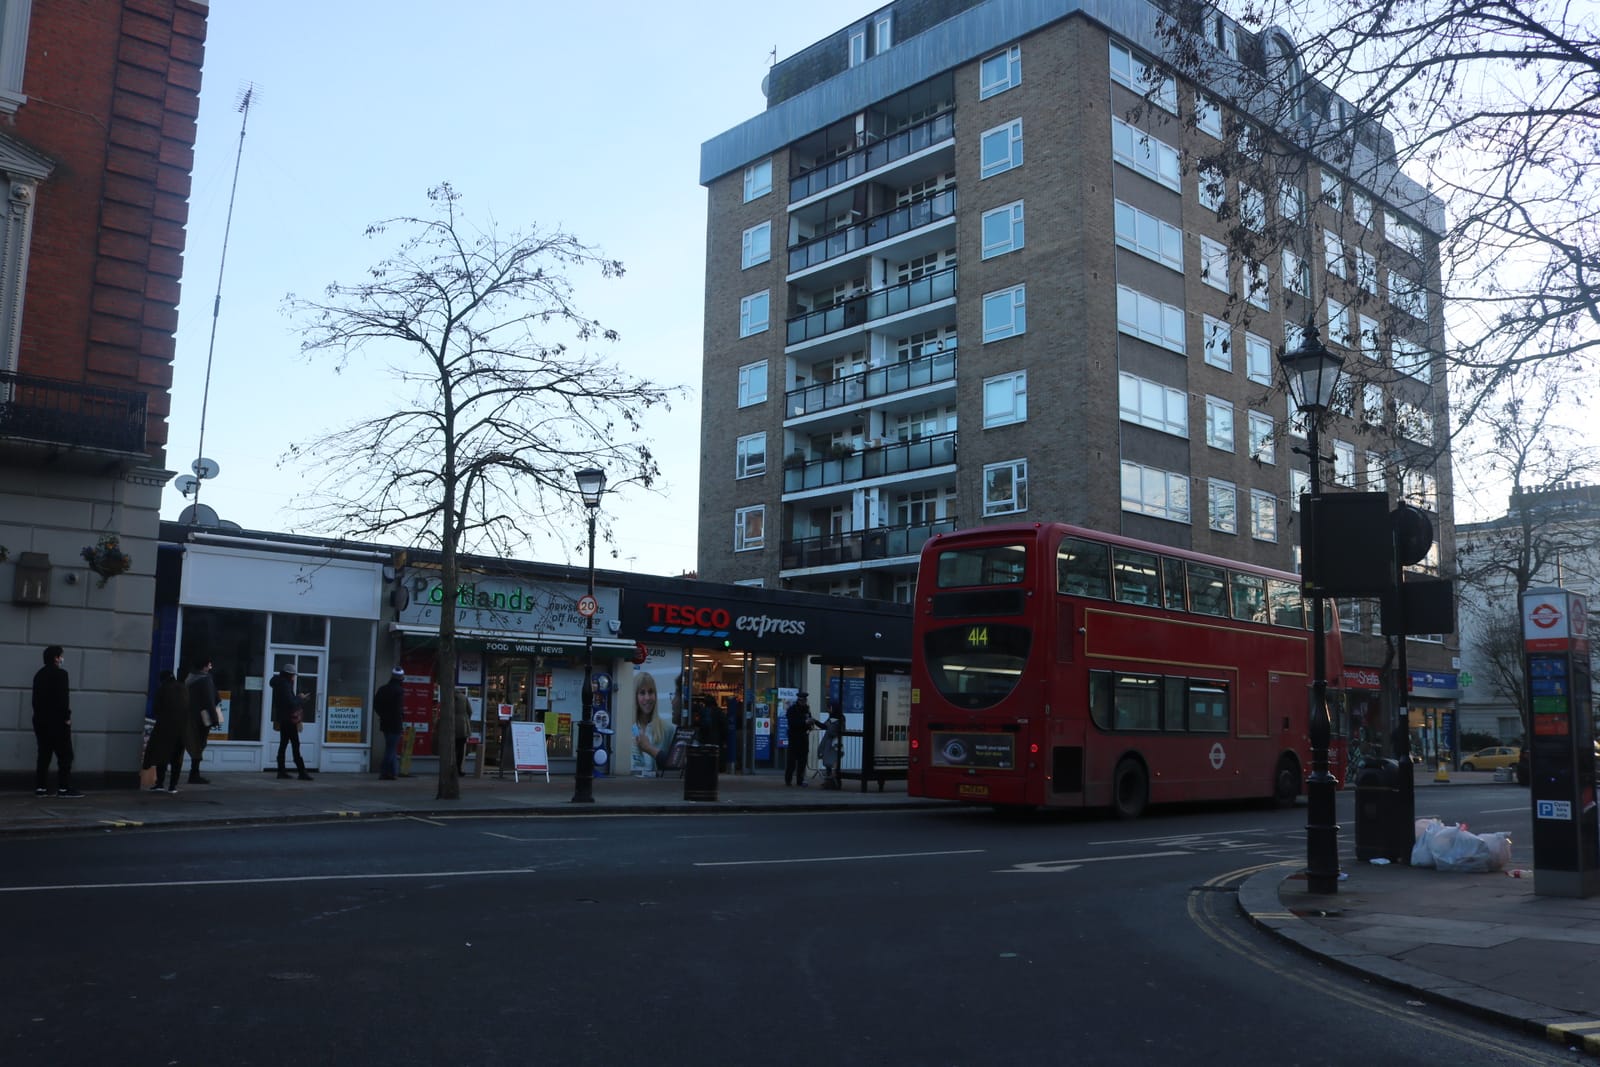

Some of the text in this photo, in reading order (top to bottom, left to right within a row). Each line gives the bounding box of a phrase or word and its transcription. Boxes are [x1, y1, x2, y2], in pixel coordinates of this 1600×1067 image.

[412, 576, 535, 612] Potlands
[581, 601, 595, 611] 20
[425, 608, 523, 626] epress
[646, 602, 806, 639] TESCO express
[968, 626, 988, 647] 414
[486, 642, 509, 651] FOOD
[515, 645, 536, 653] WINE
[1542, 804, 1551, 815] P
